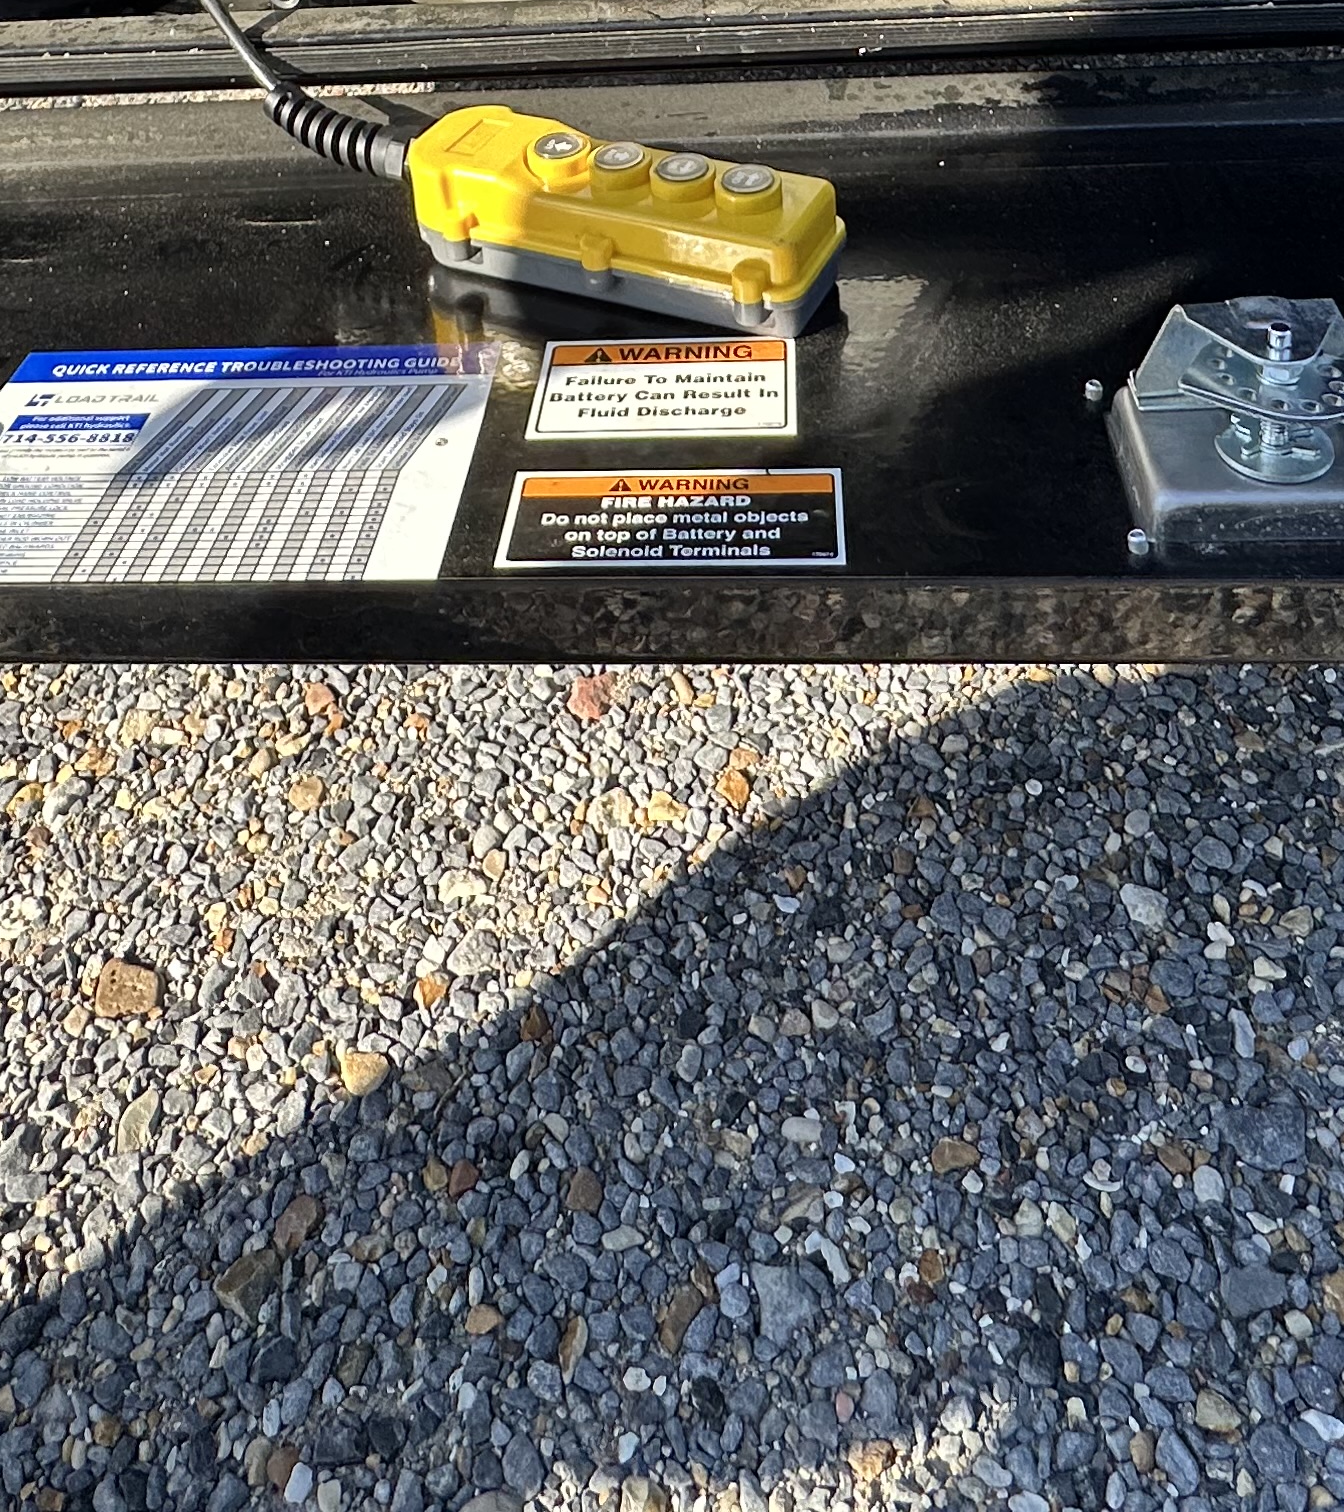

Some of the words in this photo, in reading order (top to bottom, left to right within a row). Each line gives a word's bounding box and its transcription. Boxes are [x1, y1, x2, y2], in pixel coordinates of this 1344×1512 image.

[619, 345, 753, 361] WARNING
[52, 363, 110, 377] QUICK
[112, 361, 217, 375] REFERENCE
[221, 357, 400, 373] TROUBLESHOOTING
[404, 356, 460, 369] GUIDE
[565, 375, 636, 386] Failure
[644, 374, 667, 384] To
[674, 371, 766, 384] Maintain
[54, 395, 107, 404] LOAD
[109, 393, 159, 403] TRAIL
[549, 391, 628, 403] Battery
[635, 389, 675, 401] Can
[683, 388, 751, 399] Result
[759, 387, 779, 399] In
[577, 406, 629, 418] Fluid
[637, 405, 747, 418] Discharge
[638, 477, 750, 491] WARNING
[601, 495, 652, 508] FIRE
[657, 494, 752, 508] HAZARD
[540, 512, 570, 526] Do
[573, 512, 607, 525] not
[611, 511, 668, 527] place
[672, 510, 728, 524] metal
[733, 510, 809, 526] objects
[564, 530, 592, 541] on
[596, 527, 630, 543] top
[635, 527, 658, 540] of
[662, 527, 737, 543] Battery
[741, 527, 781, 540] and
[571, 544, 663, 558] Solenoid
[669, 543, 771, 557] Terminals
